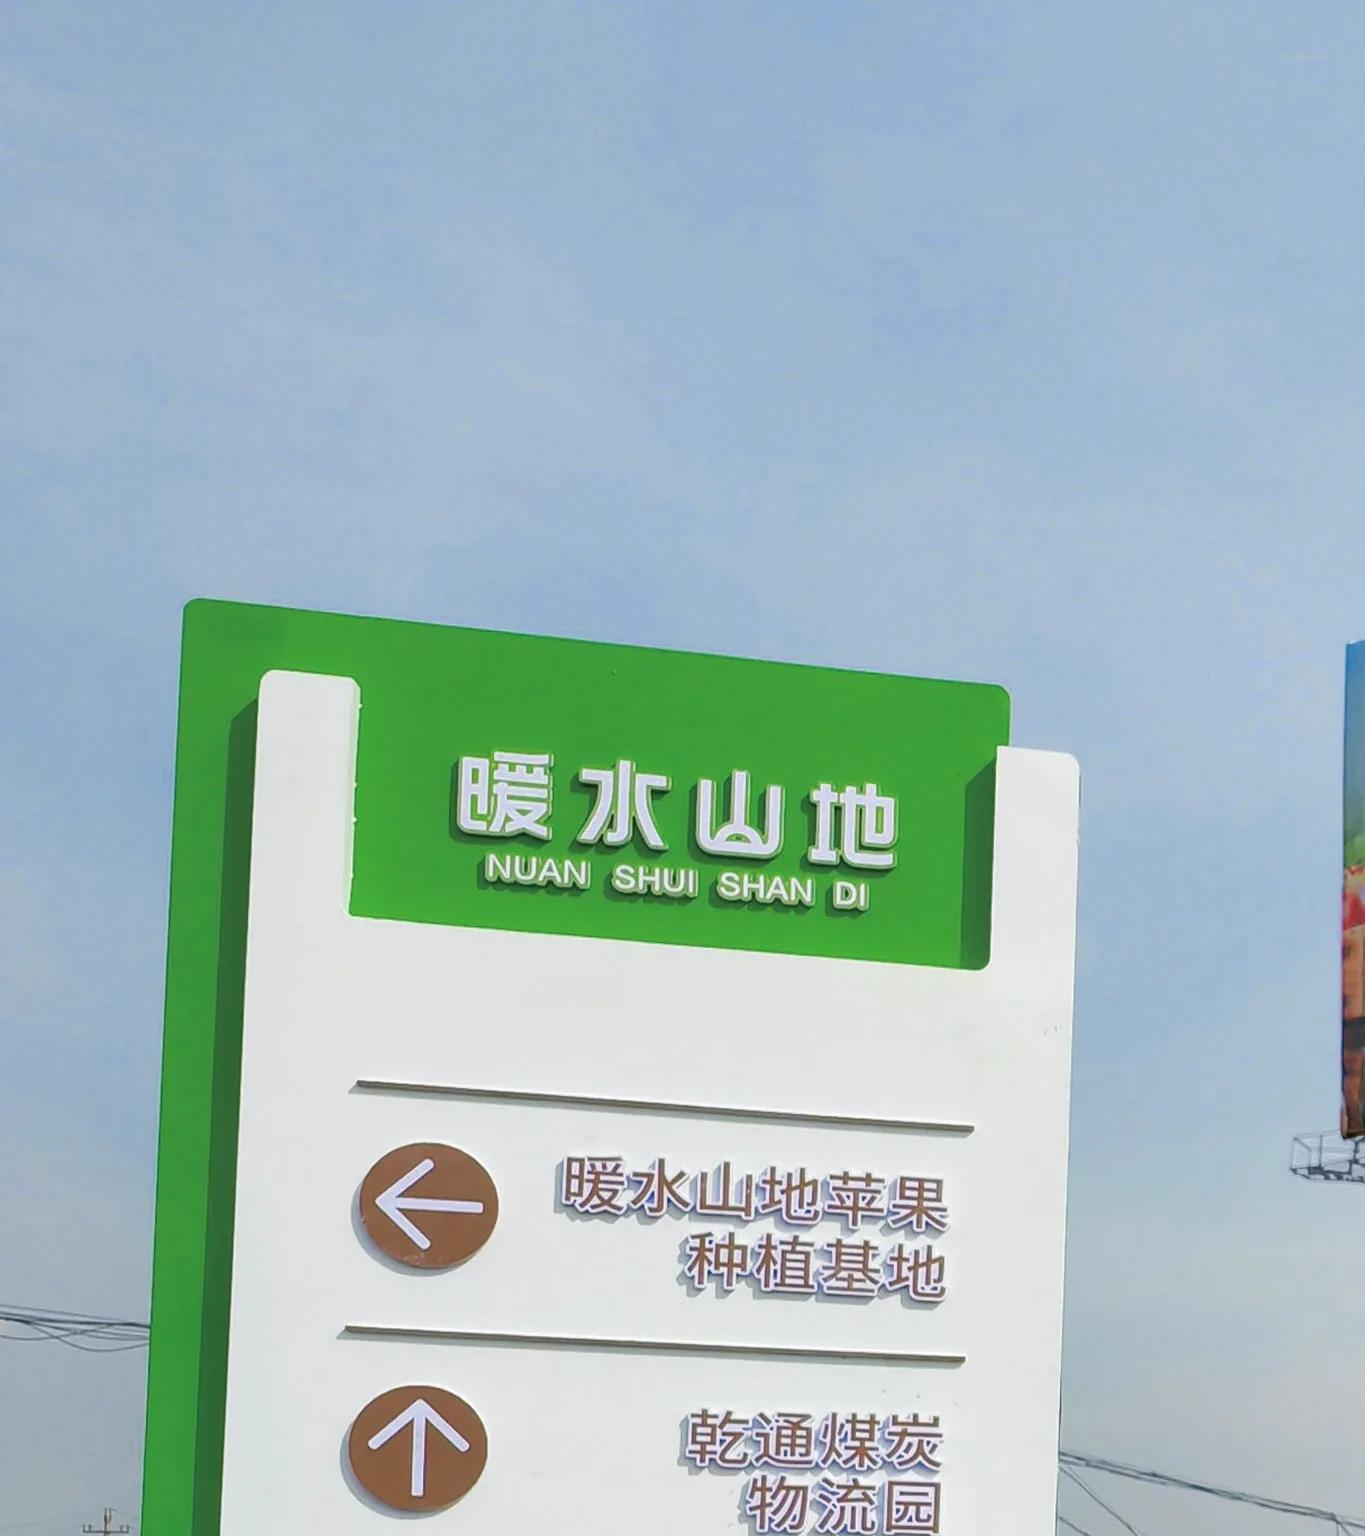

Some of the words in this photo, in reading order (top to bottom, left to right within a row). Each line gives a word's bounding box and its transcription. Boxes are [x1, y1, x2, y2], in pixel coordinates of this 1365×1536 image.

[458, 750, 898, 869] 暖水山地
[484, 852, 591, 889] NUAN
[611, 864, 699, 897] SHUI
[717, 872, 815, 906] SHAN
[832, 881, 869, 911] DI
[562, 1153, 950, 1233] 暖水山地苹果
[685, 1230, 948, 1302] 种植基地
[685, 1408, 944, 1471] 乾通煤炭
[745, 1476, 943, 1536] 物流园
